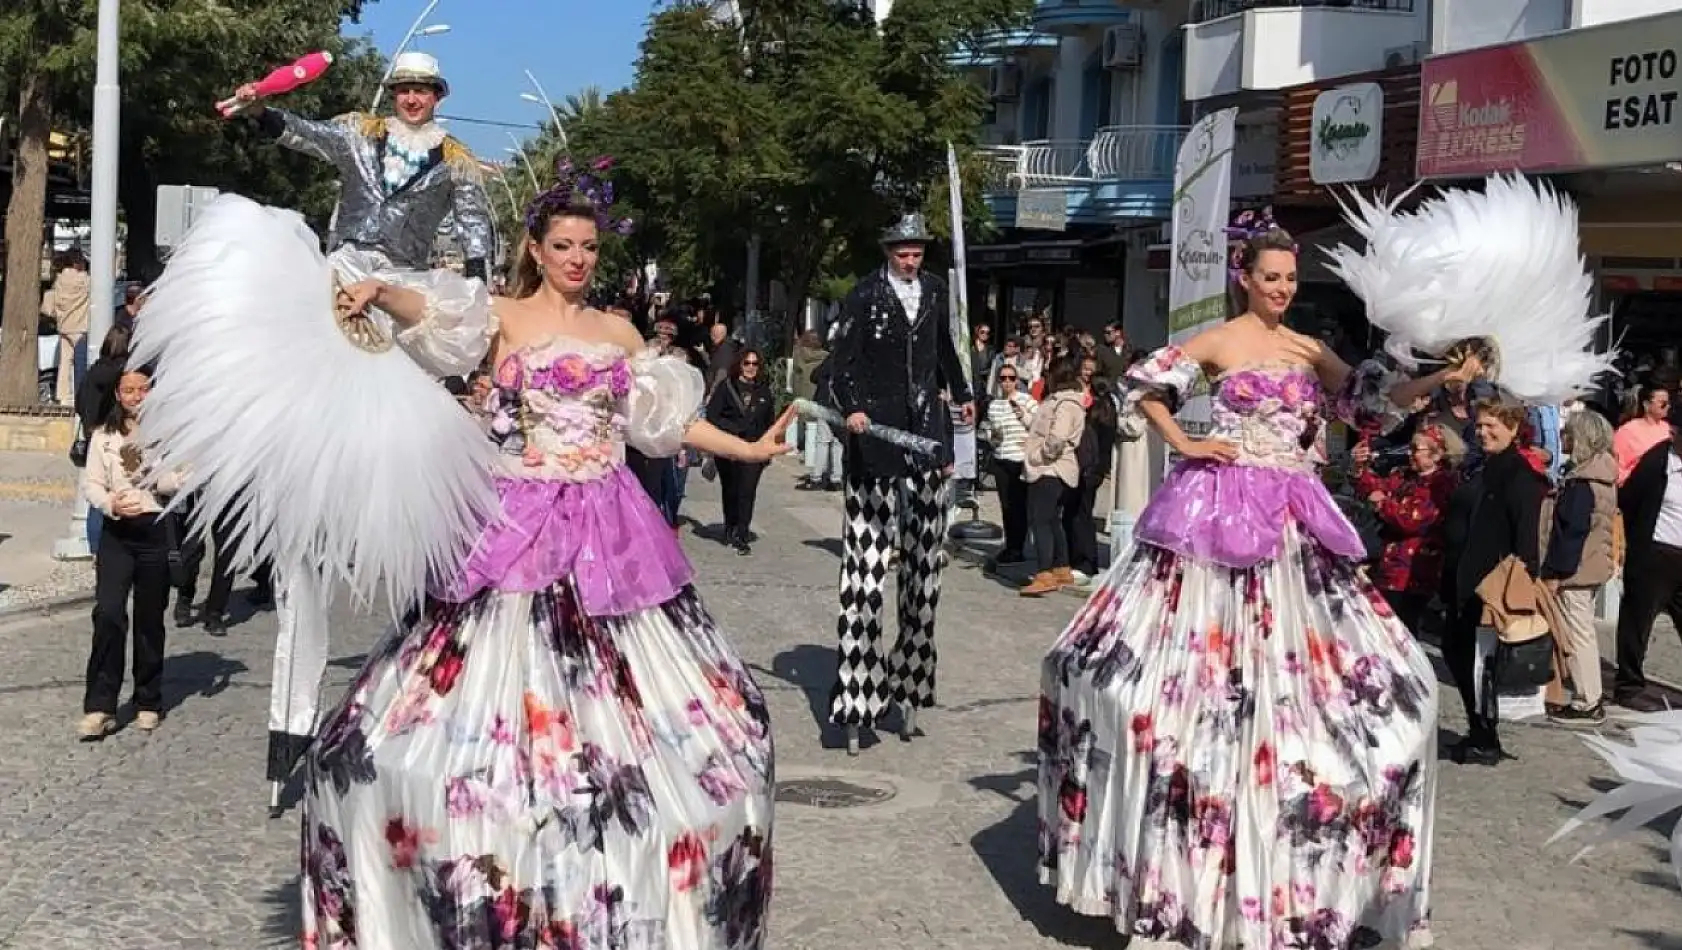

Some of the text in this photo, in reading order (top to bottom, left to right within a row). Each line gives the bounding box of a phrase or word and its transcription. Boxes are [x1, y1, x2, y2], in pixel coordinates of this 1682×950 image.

[1609, 49, 1677, 86] FOTO
[1460, 98, 1513, 128] Kodak
[1604, 91, 1678, 130] ESAT
[1437, 123, 1526, 158] EXPRESS
